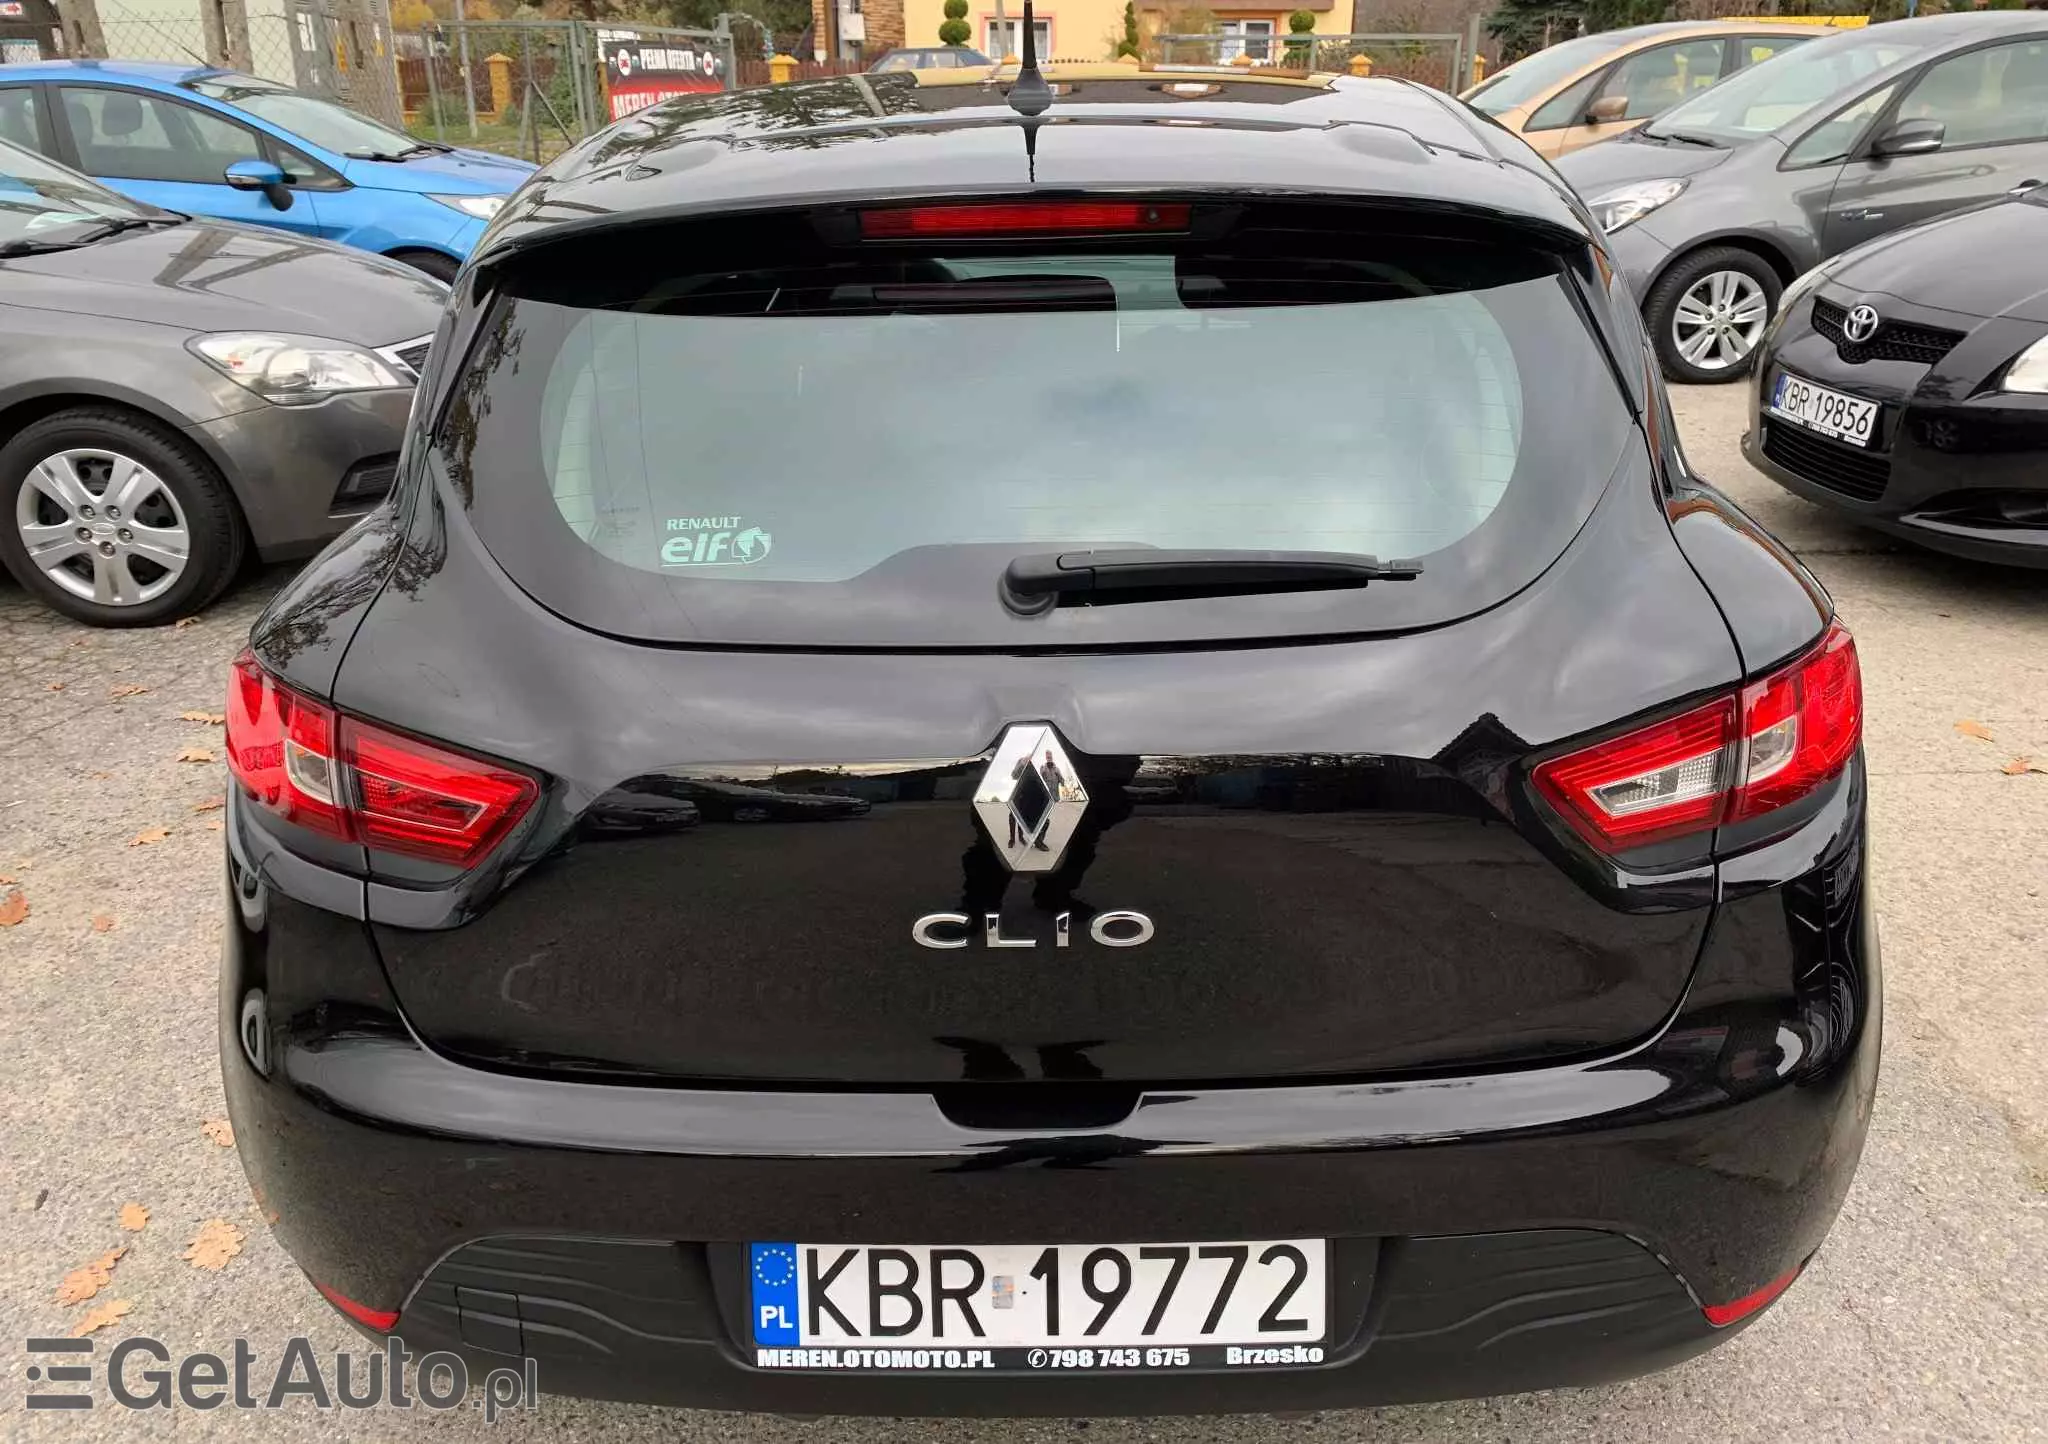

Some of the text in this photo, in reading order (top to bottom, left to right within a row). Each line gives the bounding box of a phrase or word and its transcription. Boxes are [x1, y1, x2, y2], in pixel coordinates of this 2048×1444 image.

[1781, 381, 1810, 417] KBR
[1816, 391, 1873, 435] 19856
[666, 516, 741, 531] RENAULT
[660, 531, 731, 563] elf
[912, 911, 1155, 949] CLIO
[806, 1243, 1309, 1338] KBR 19772
[760, 1305, 793, 1329] PL
[757, 1345, 1324, 1368] MEREN.OTOMOTO.PL 798 743 675 Brzesko
